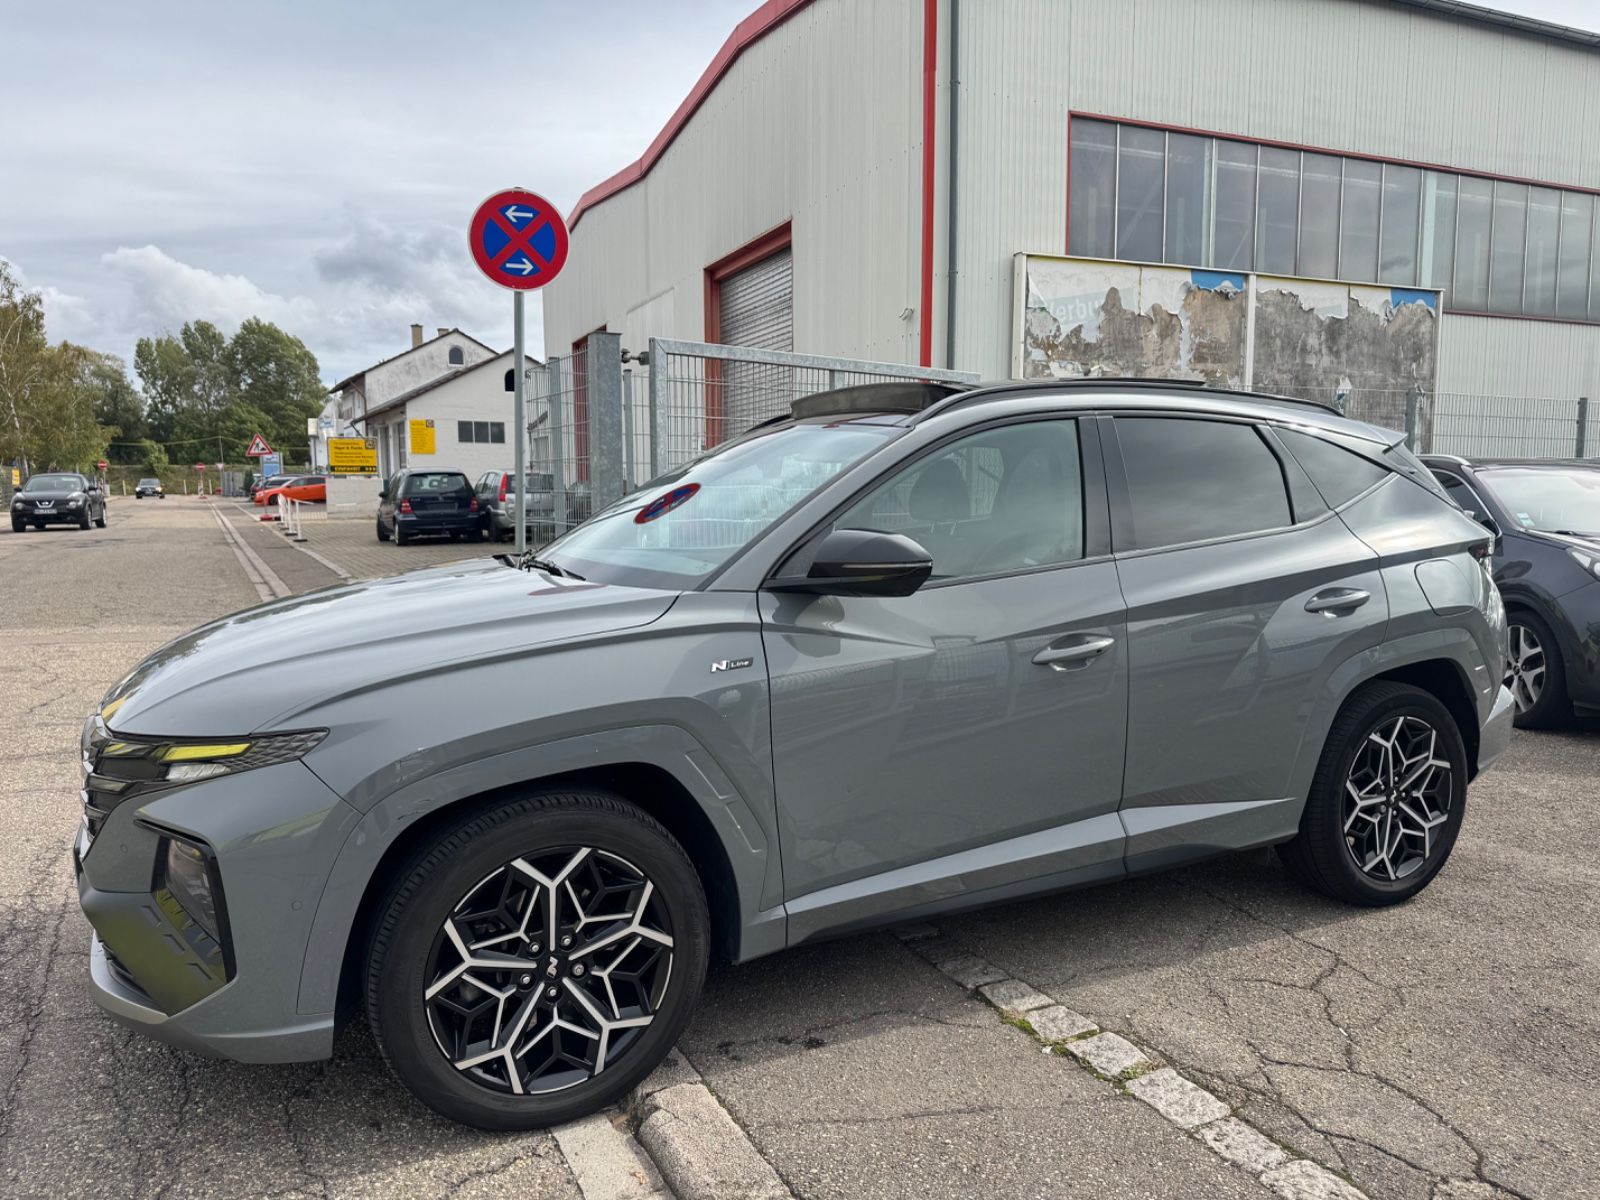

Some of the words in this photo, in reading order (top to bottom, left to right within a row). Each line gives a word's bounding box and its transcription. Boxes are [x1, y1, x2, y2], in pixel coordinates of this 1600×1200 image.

[1050, 296, 1099, 321] erbu
[711, 660, 727, 672] N
[731, 660, 749, 668] Line
